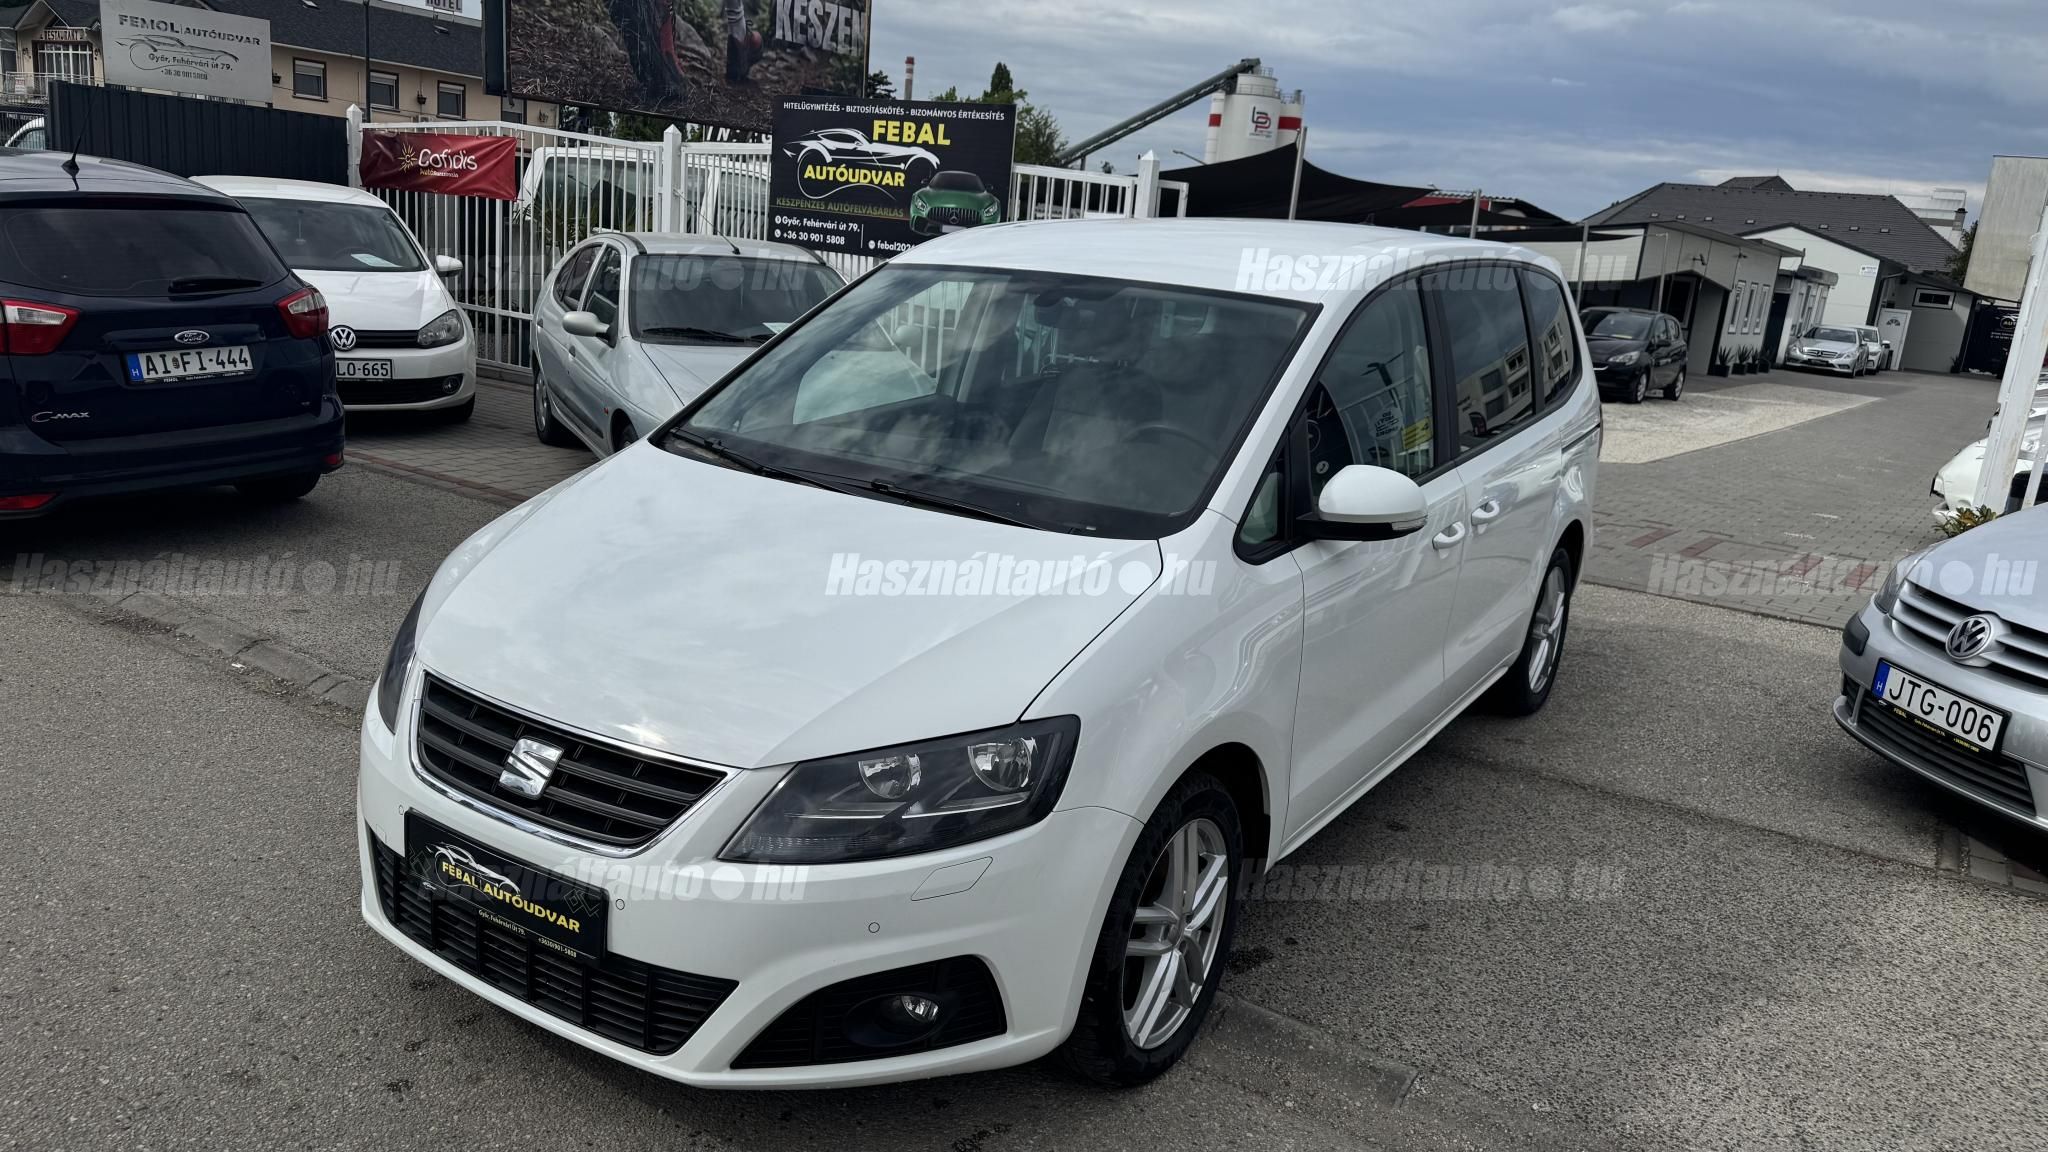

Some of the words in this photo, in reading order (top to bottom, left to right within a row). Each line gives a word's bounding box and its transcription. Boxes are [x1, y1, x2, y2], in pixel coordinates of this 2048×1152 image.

[118, 14, 180, 34] FEMOL
[182, 26, 261, 45] AUTÓUDVAR
[783, 101, 840, 112] HITELÜGYINTÉZÉS
[846, 104, 904, 115] BIZTOSÍTÁSKÖTÉS
[910, 107, 957, 119] BIZOMÁNYOS
[958, 109, 1005, 121] ÉRTÉKESÍTÉS
[872, 119, 951, 146] FEBAL
[418, 148, 478, 170] Cofidis
[803, 163, 906, 187] AUTÓUDVAR
[782, 215, 801, 227] Győr,
[802, 217, 837, 230] Fehérvári
[838, 221, 847, 231] út
[848, 222, 860, 232] 79.
[783, 230, 797, 239] +36
[798, 231, 808, 240] 30
[810, 232, 824, 242] 901
[826, 234, 845, 245] 5808
[877, 240, 915, 252] febal202
[145, 354, 171, 376] AI
[180, 348, 249, 372] FI-444
[1889, 677, 1995, 742] JTG-006
[442, 860, 478, 889] FEBAL
[483, 882, 580, 934] AUTÓUDVAR
